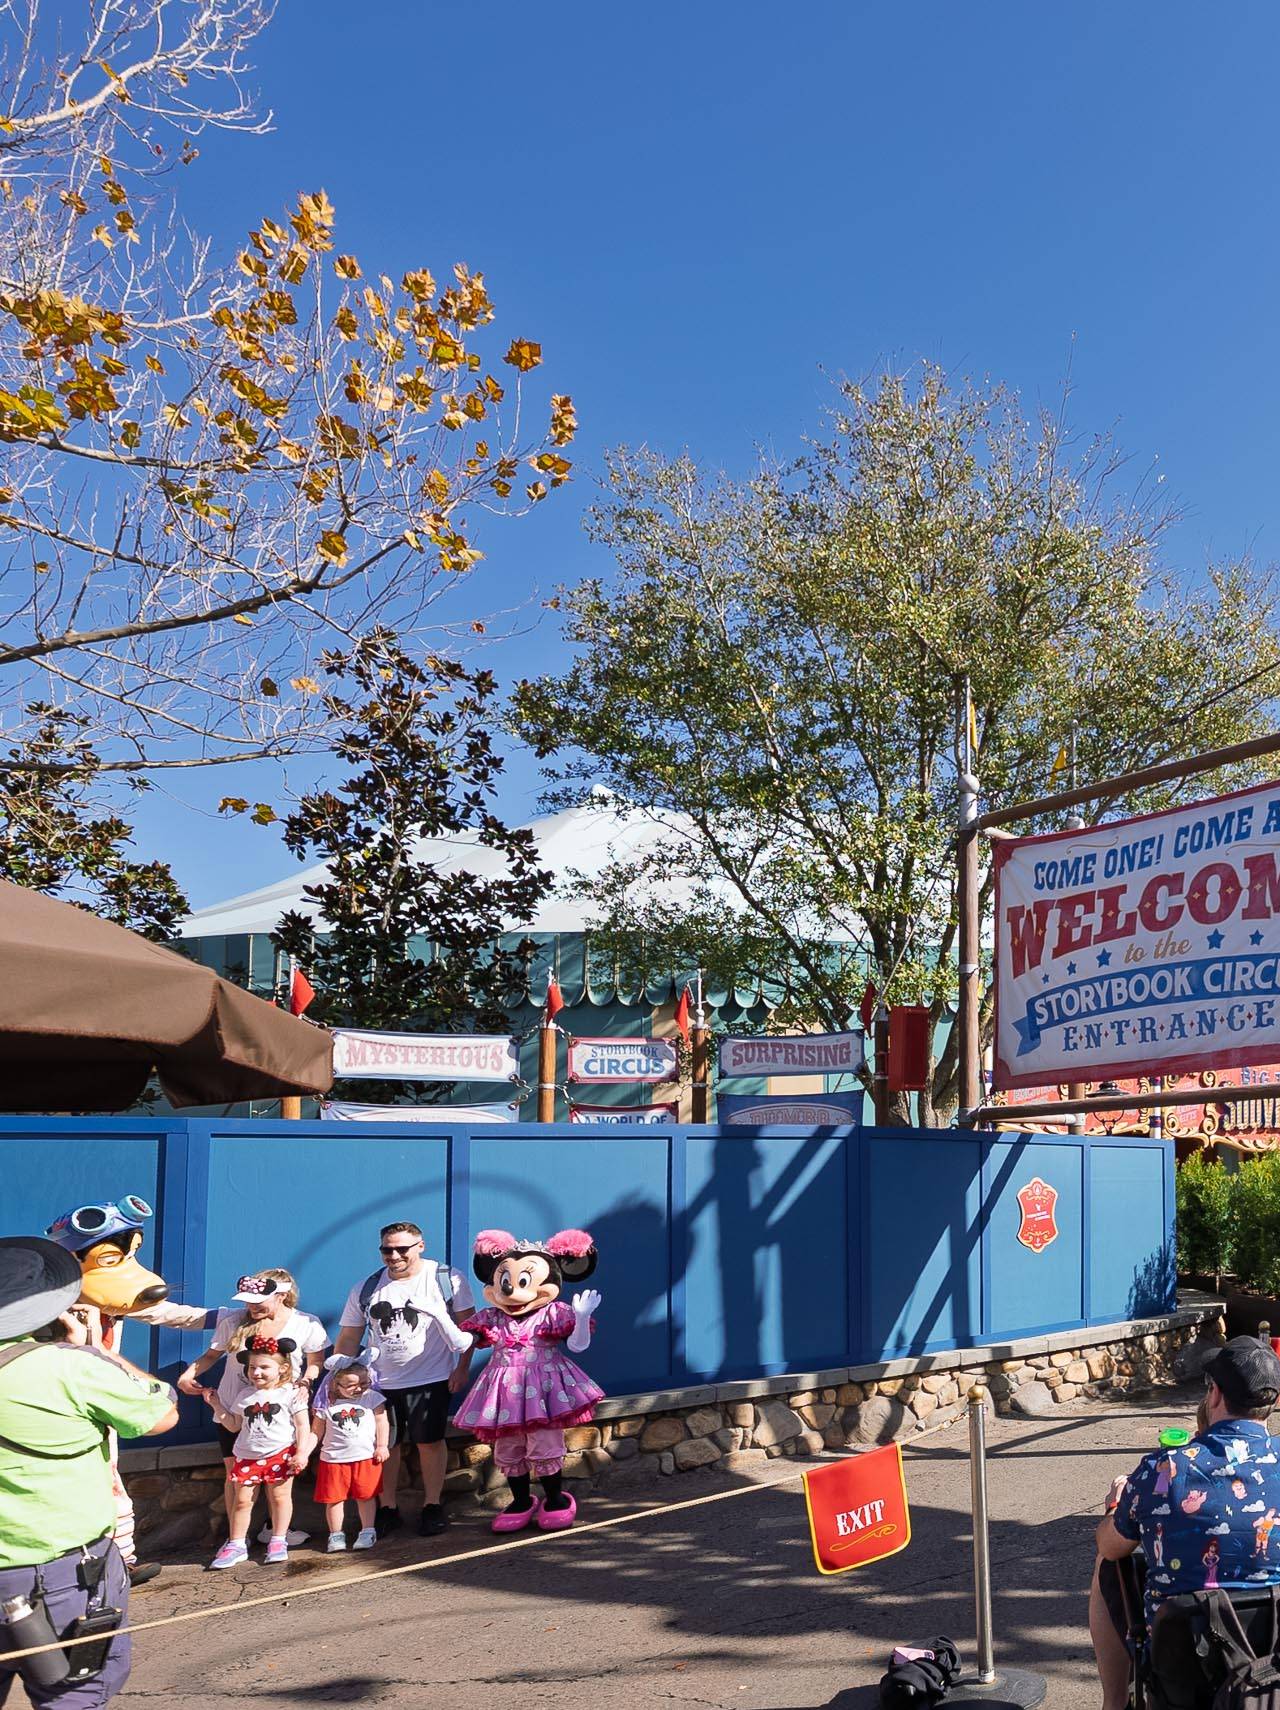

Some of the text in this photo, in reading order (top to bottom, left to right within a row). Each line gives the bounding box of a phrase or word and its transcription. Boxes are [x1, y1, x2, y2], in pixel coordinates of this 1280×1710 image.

[1033, 854, 1097, 890] COME
[1104, 833, 1163, 878] ONE!
[1174, 806, 1254, 859] COME
[1124, 931, 1192, 964] to the
[1034, 965, 1194, 1026] STORYBOOK
[1062, 999, 1275, 1052] ENTRANCE
[345, 1040, 503, 1072] MYSTERIOUS
[583, 1058, 665, 1075] CIRCUS
[591, 1045, 658, 1058] STORYBOOK
[732, 1042, 852, 1067] SURPRISING
[835, 1499, 885, 1537] EXIT
